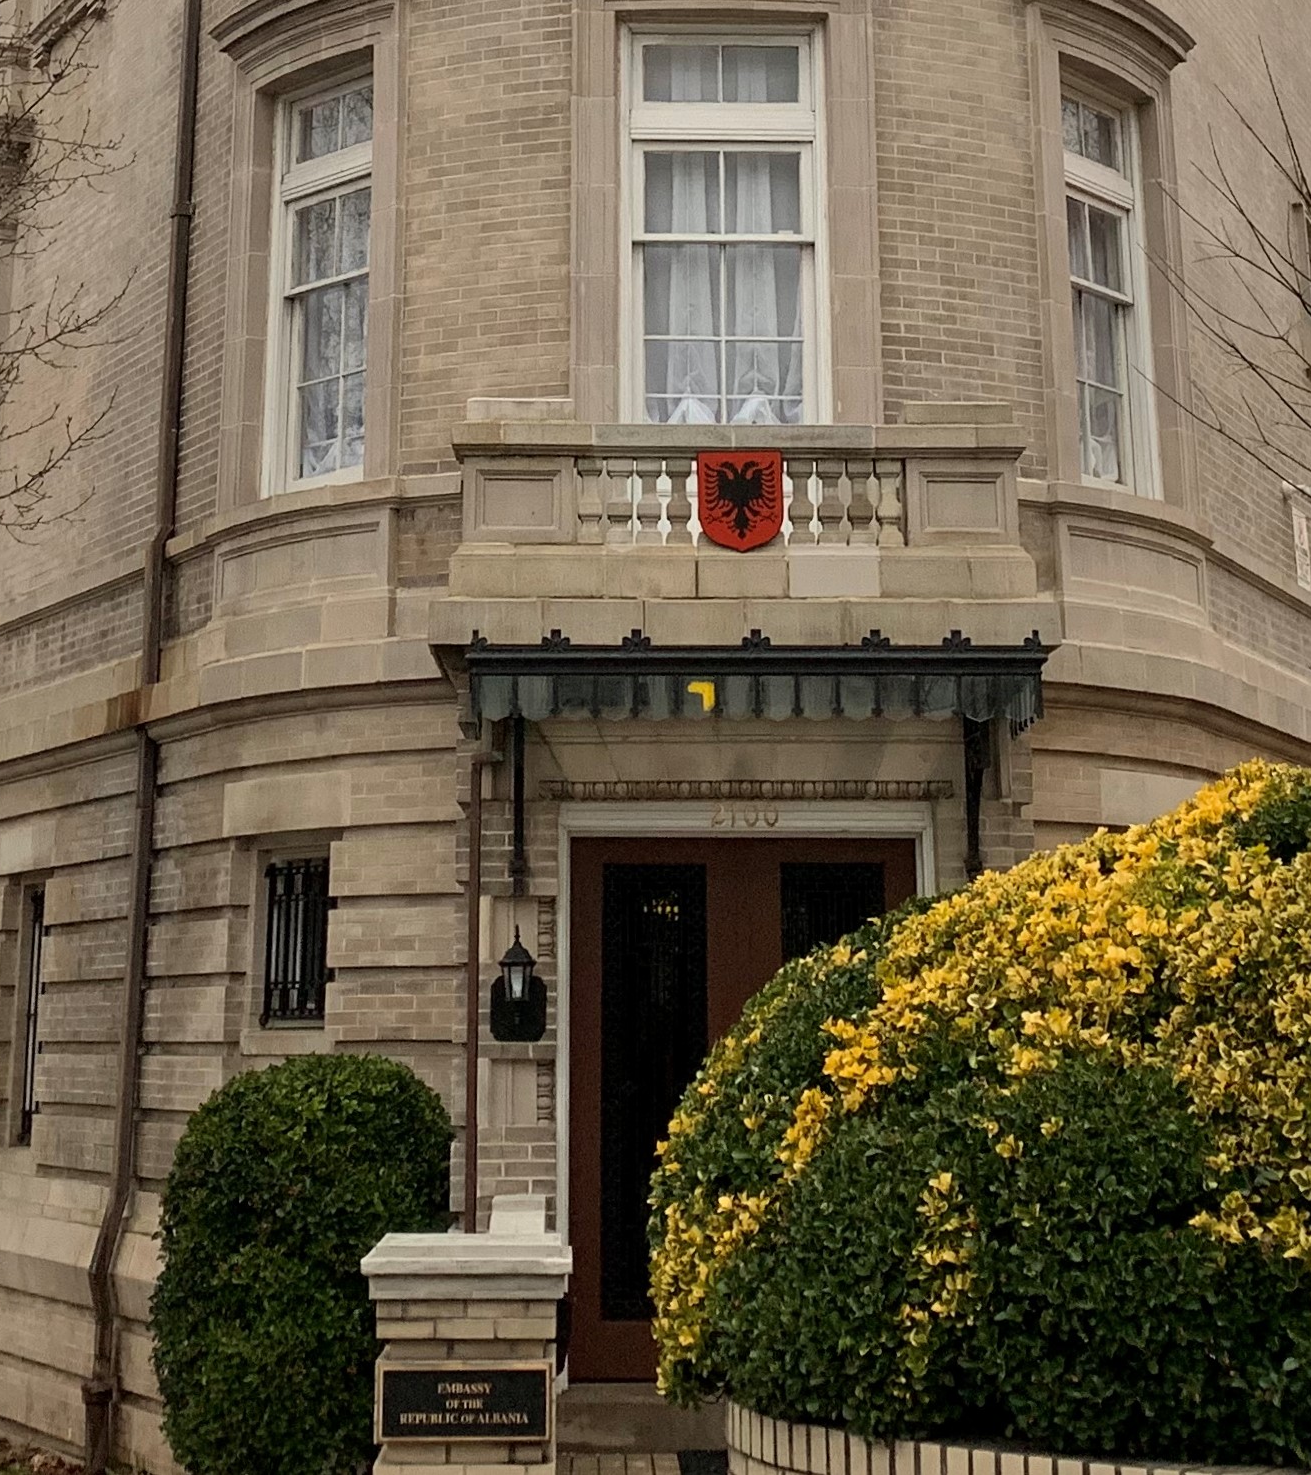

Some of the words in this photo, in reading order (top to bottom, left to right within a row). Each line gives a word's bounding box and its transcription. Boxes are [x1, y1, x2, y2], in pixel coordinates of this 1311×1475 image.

[711, 802, 779, 828] 2100
[437, 1383, 492, 1394] EMBASSY
[445, 1398, 460, 1409] OF
[462, 1398, 484, 1409] THE
[400, 1413, 458, 1424] REPUBLIC
[477, 1413, 529, 1424] ALBANIA
